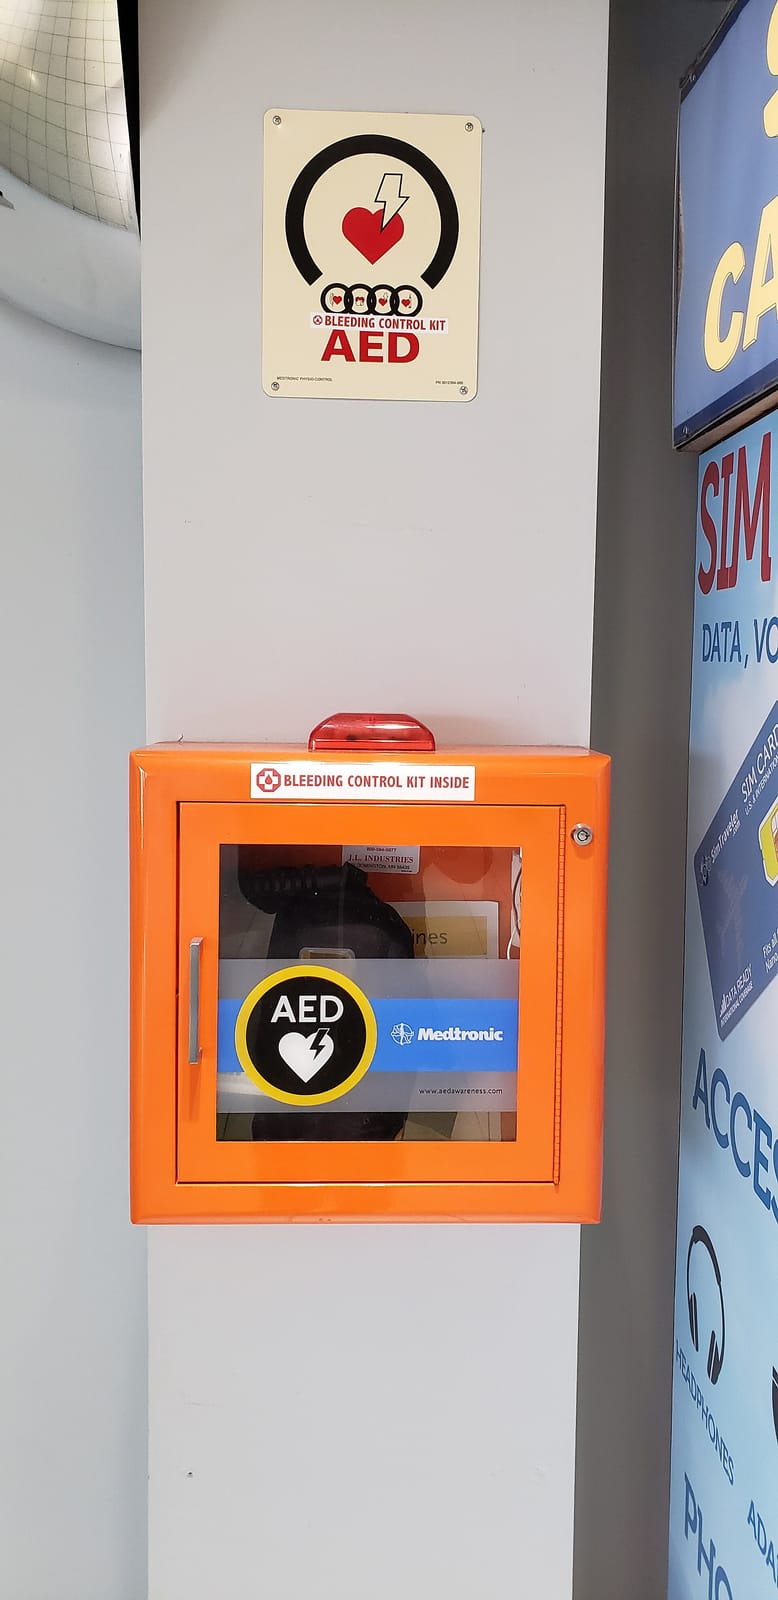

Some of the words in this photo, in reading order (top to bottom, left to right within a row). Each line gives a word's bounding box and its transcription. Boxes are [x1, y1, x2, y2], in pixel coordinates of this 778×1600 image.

[324, 315, 375, 328] BLEEDING
[378, 318, 426, 330] CONTROL
[429, 319, 446, 331] KIT
[320, 329, 420, 363] AED
[697, 431, 772, 596] SIM
[284, 774, 343, 787] BLEEDING
[347, 775, 402, 788] CONTROL
[406, 776, 425, 788] KIT
[430, 776, 469, 789] INSIDE
[741, 766, 757, 803] SIM
[710, 808, 740, 864] SimTraveler
[364, 855, 414, 863] INDUSTRIES
[736, 963, 752, 993] READY
[270, 994, 345, 1024] AED
[417, 1027, 504, 1042] Medtronic
[418, 1087, 503, 1096] www.aedawareness.com
[675, 1339, 734, 1486] HEADPHONES
